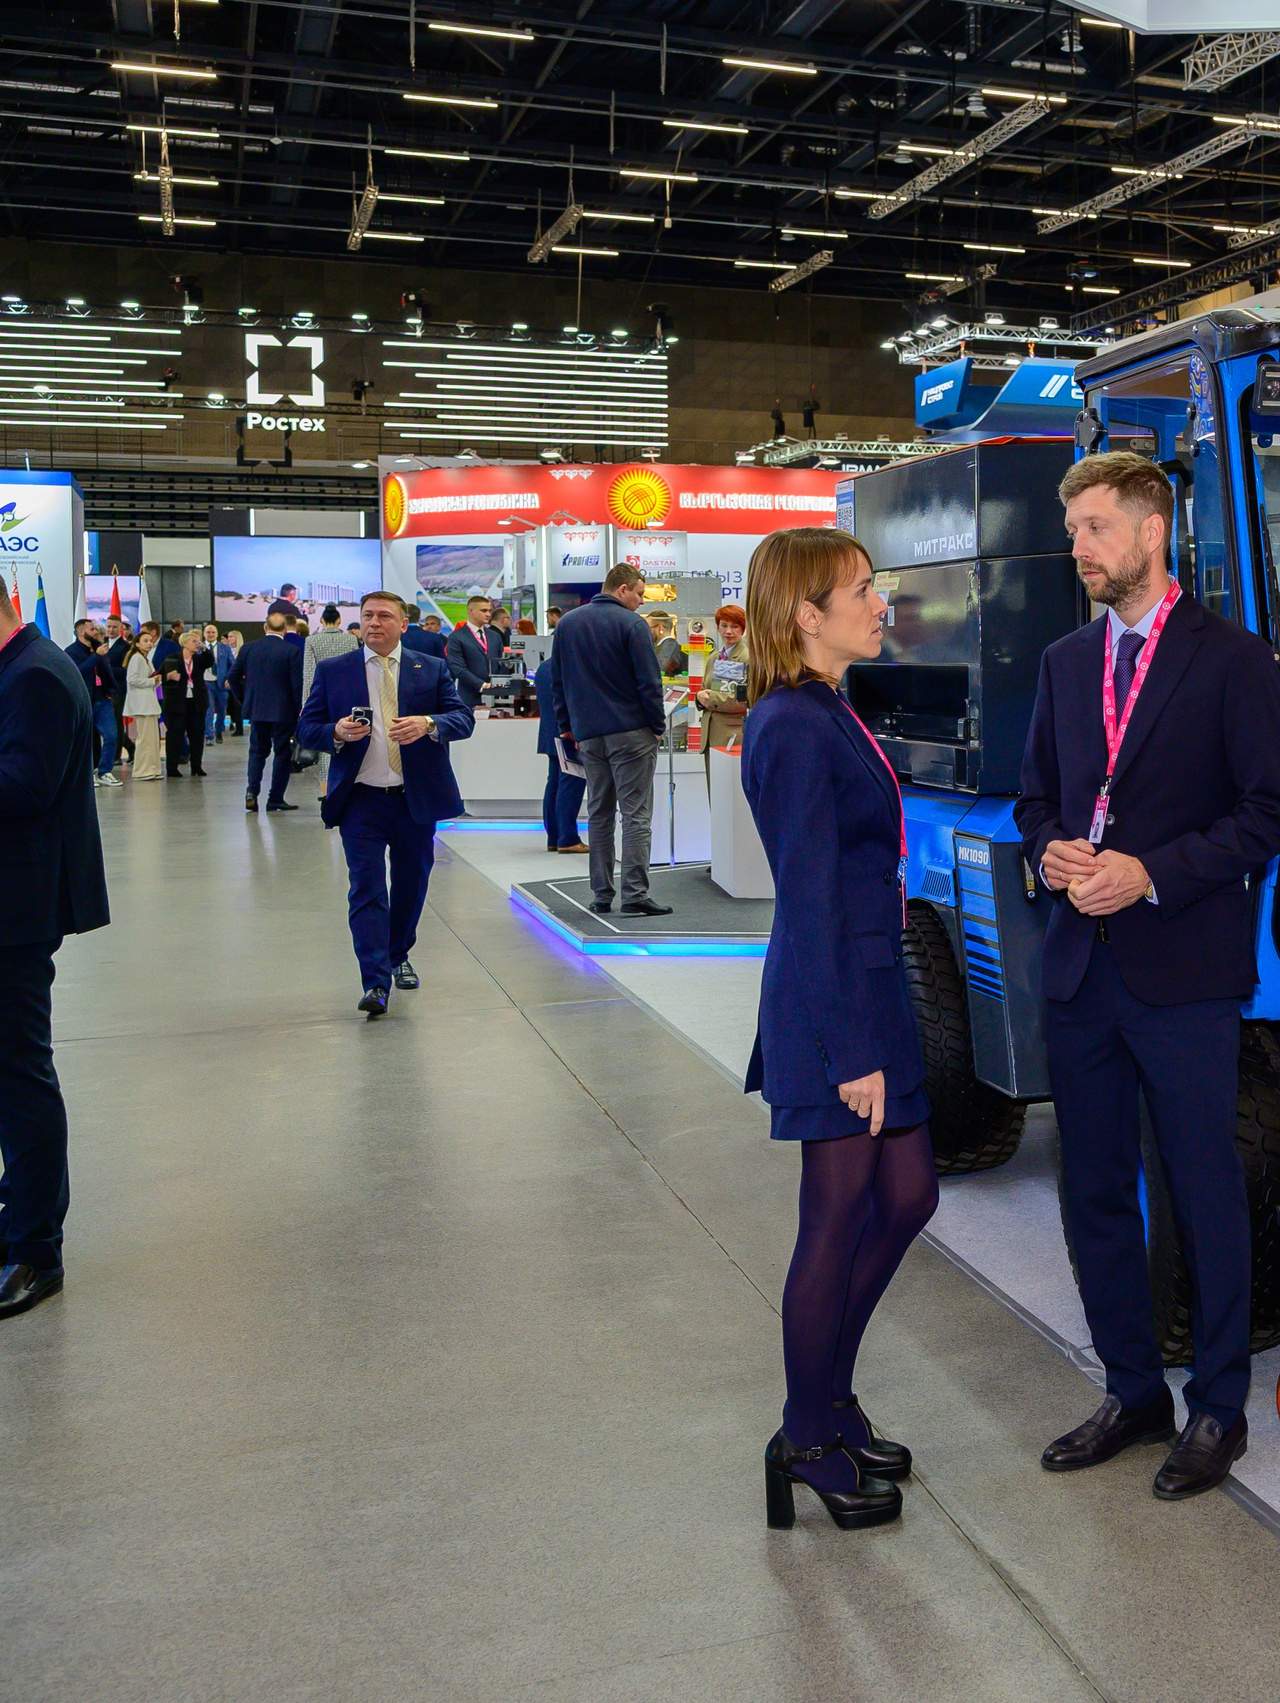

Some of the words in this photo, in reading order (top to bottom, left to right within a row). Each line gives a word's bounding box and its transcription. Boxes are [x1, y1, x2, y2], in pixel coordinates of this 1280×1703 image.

[246, 412, 326, 432] Ростех
[679, 492, 773, 510] КЫРГЫЗСКАЯ
[914, 532, 973, 557] МИТРАКС
